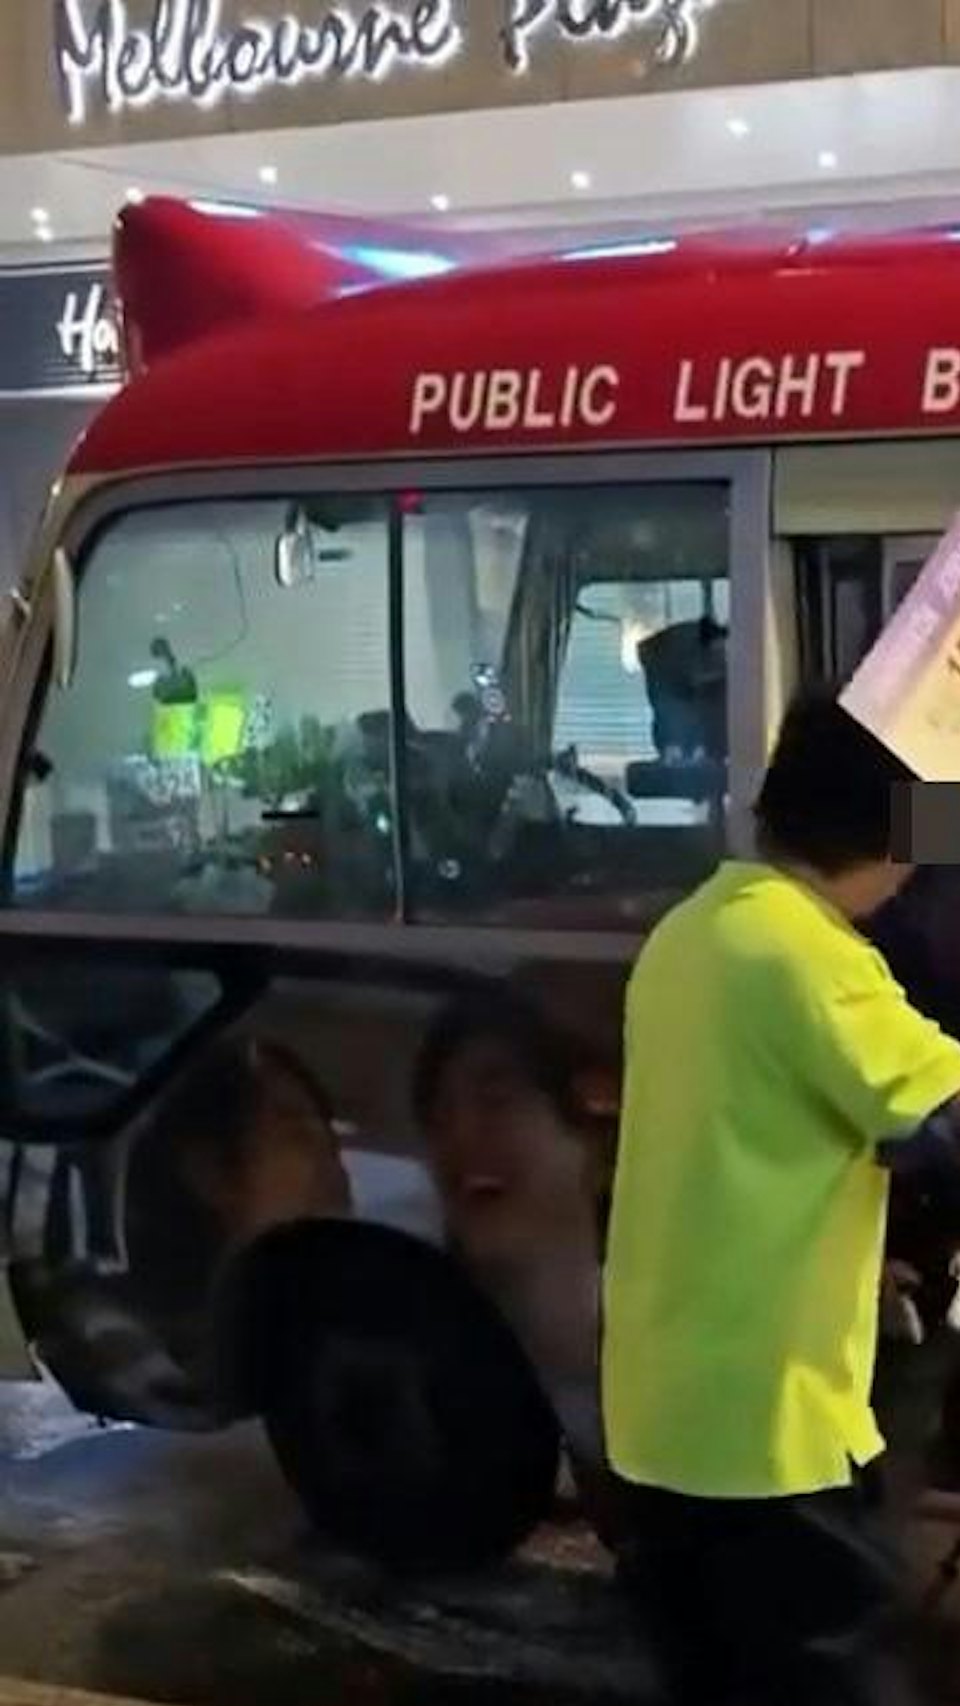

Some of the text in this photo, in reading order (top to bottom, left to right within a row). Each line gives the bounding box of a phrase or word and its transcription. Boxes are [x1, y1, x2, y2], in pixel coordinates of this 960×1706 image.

[54, 0, 460, 120] Melbourne
[409, 365, 618, 434] PUBLIC
[673, 351, 864, 422] LIGHT
